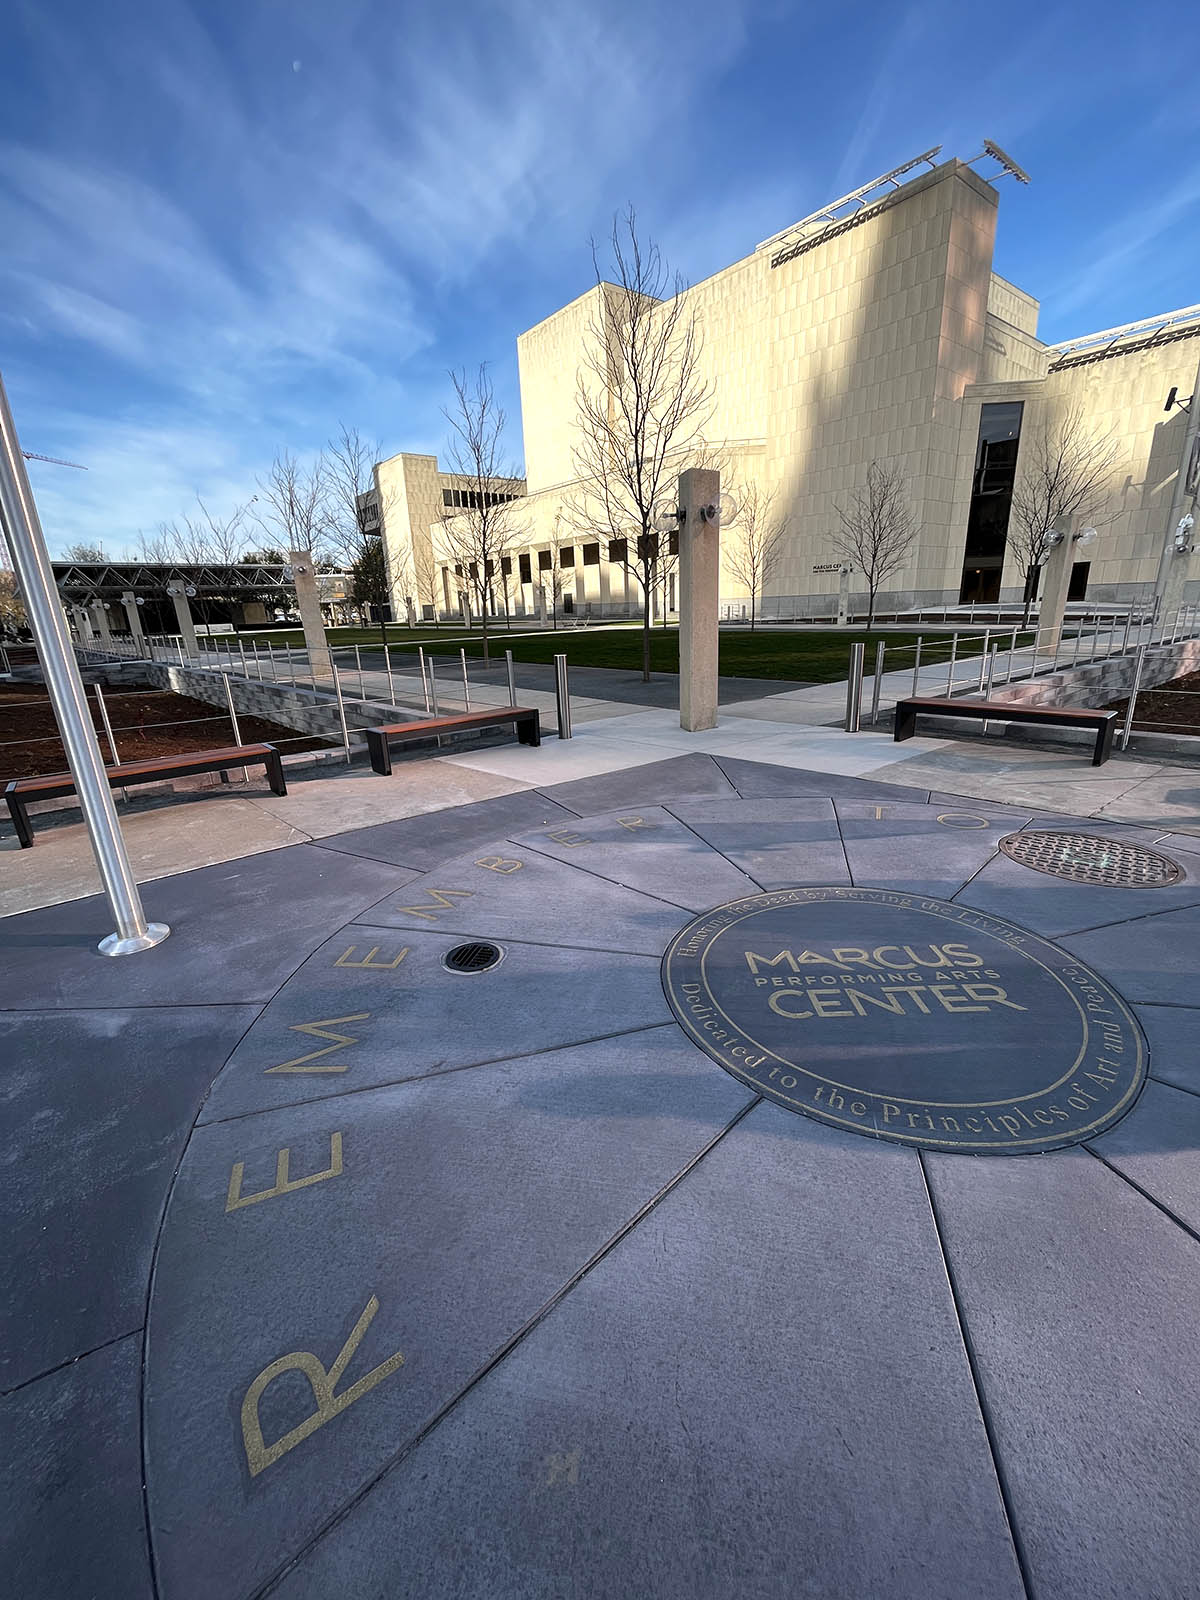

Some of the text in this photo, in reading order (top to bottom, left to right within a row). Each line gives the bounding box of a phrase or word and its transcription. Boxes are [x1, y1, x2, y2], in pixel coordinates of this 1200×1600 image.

[677, 888, 1027, 958] Honoring the Dead by Serving the Living
[744, 944, 984, 974] MARCUS
[755, 969, 1001, 987] PERFORMING ARTS
[767, 983, 1028, 1018] CENTER
[681, 968, 1124, 1137] Dedicated to the Principles of Art and Peace
